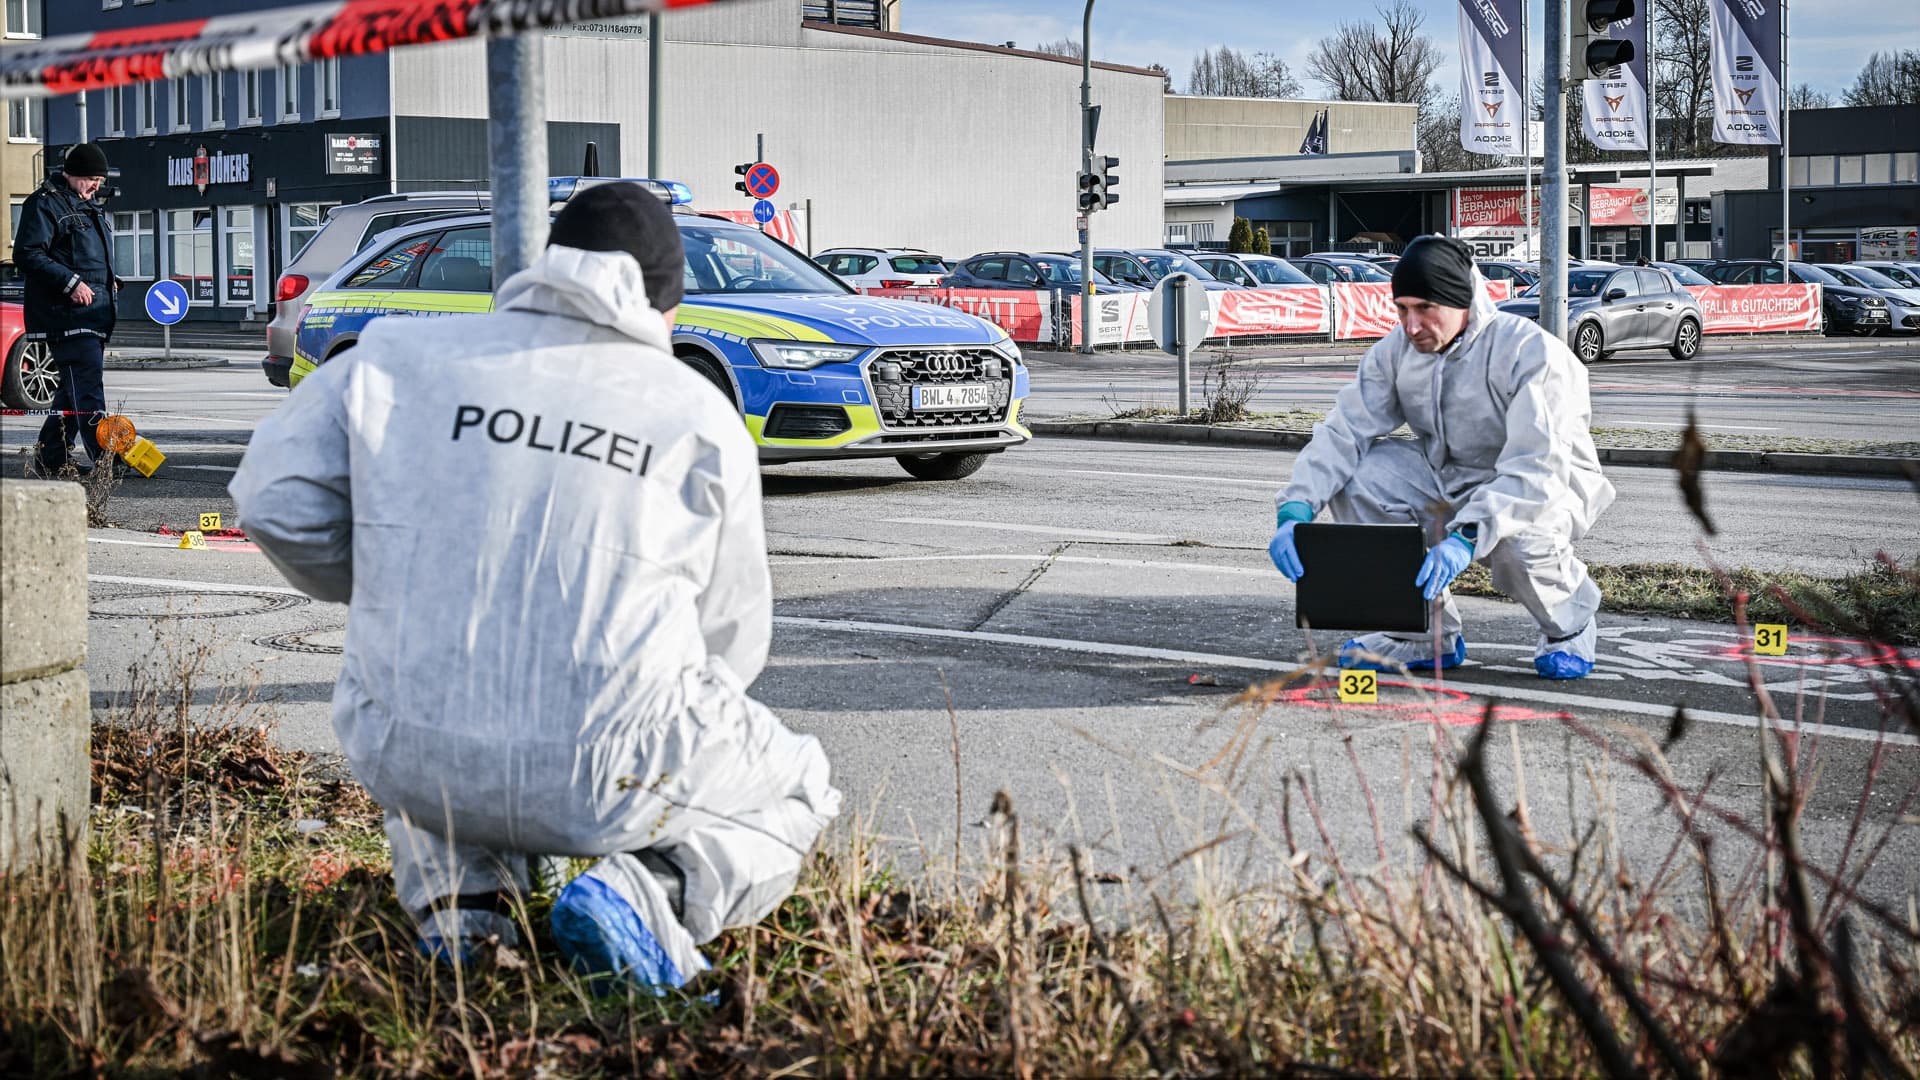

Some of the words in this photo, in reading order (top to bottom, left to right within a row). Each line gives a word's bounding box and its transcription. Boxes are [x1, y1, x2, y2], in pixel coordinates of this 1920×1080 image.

[168, 155, 193, 186] HAUS
[210, 150, 249, 184] DÖNERS
[1592, 196, 1632, 210] GEBRAUCHT
[1701, 299, 1728, 314] FALL
[1731, 299, 1739, 314] &
[1741, 298, 1801, 314] GUTACHTEN
[843, 315, 977, 330] POLIZEI
[921, 388, 944, 406] BWL
[946, 388, 953, 405] 4
[961, 387, 987, 405] 7854
[451, 405, 653, 477] POLIZEI
[202, 515, 218, 527] 37
[190, 534, 205, 546] 36
[1756, 629, 1782, 648] 31
[1344, 675, 1374, 695] 32
